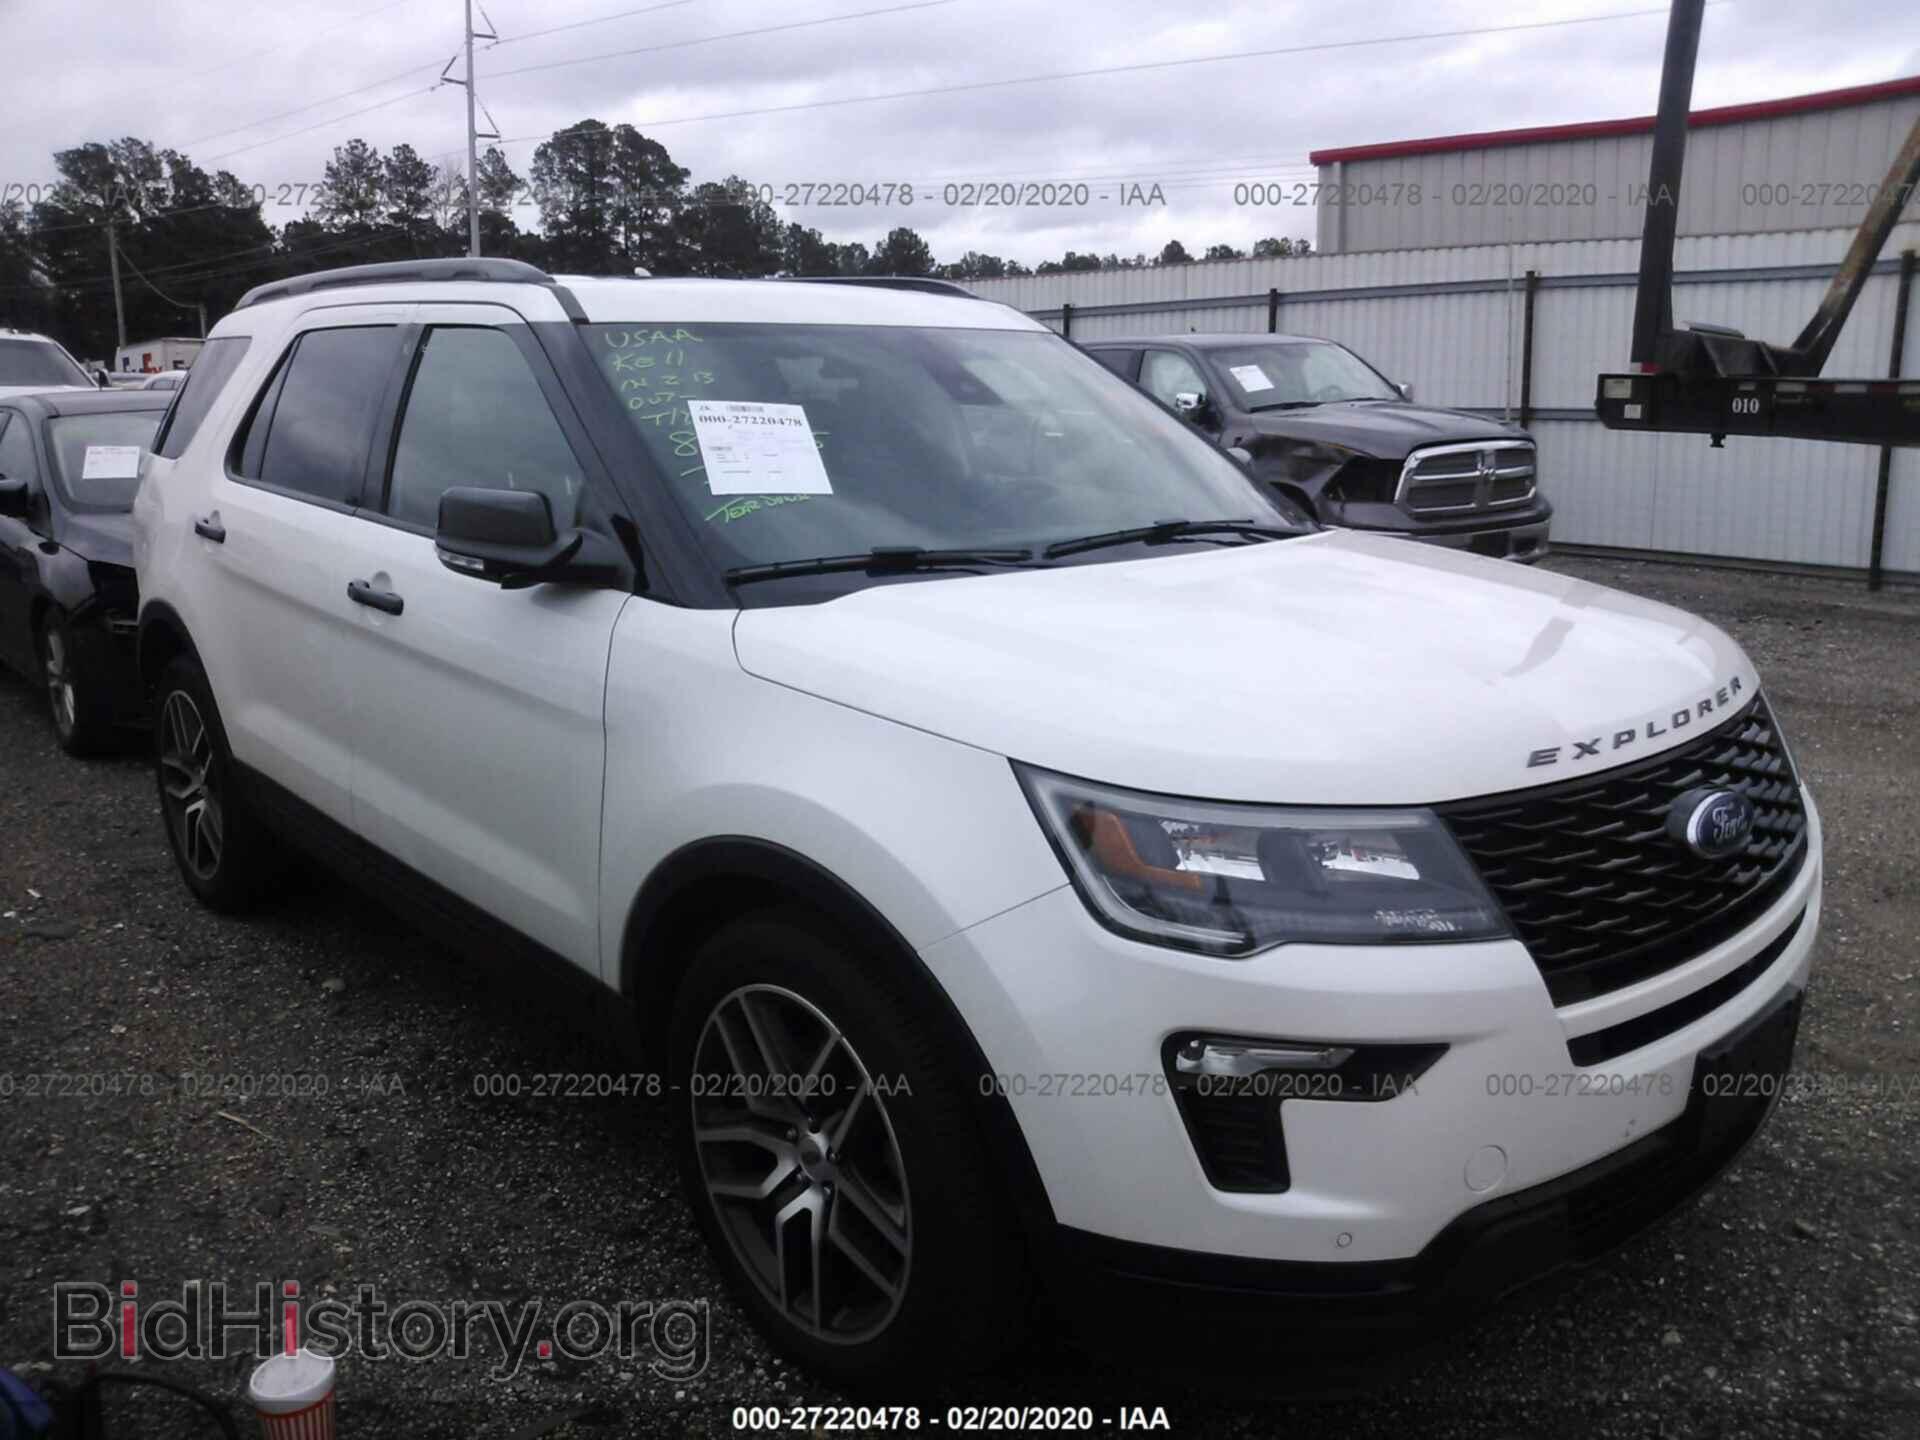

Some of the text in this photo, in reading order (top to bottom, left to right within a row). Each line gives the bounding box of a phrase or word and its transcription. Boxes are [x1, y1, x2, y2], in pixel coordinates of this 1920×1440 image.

[1732, 398, 1759, 413] 010
[699, 415, 803, 427] 000-27220478
[1526, 676, 1742, 768] EXPLORER
[1712, 802, 1746, 840] Ford
